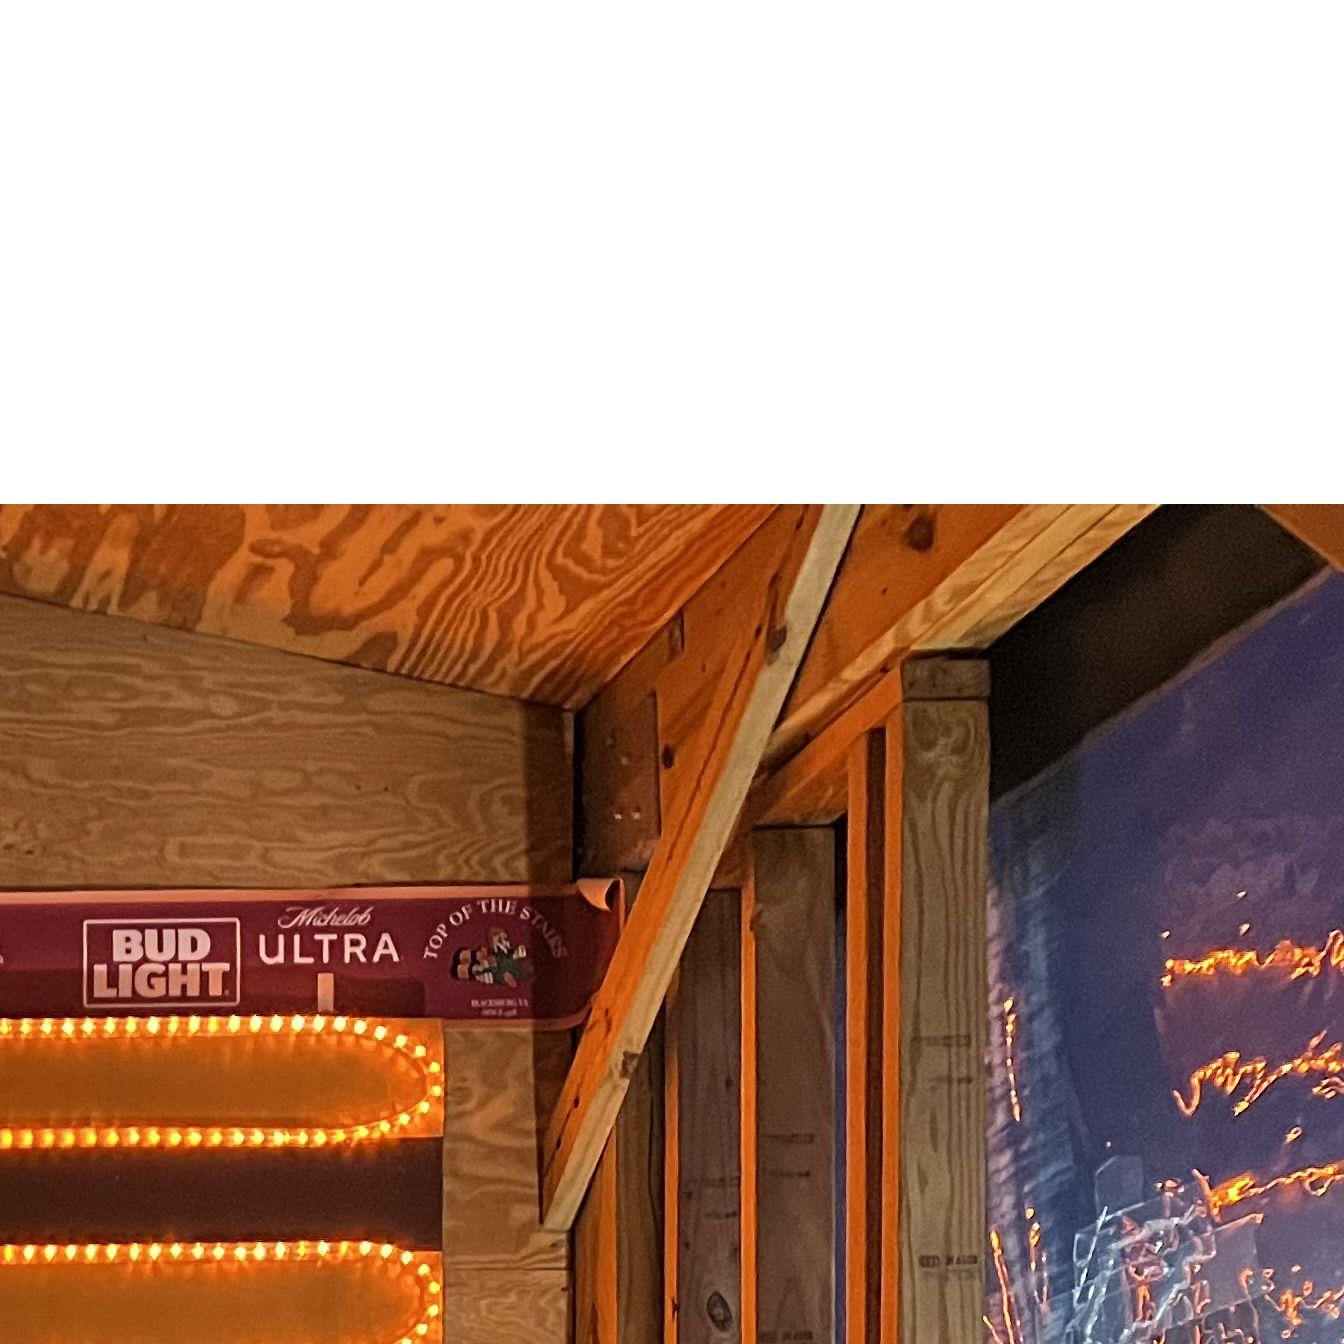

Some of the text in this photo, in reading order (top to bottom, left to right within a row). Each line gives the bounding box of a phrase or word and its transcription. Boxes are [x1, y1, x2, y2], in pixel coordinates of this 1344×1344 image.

[278, 905, 372, 929] Michelob
[423, 923, 449, 960] TOP
[449, 903, 473, 926] OF
[477, 898, 517, 916] THE
[112, 928, 212, 963] BUD
[258, 932, 400, 965] ULTRA
[92, 963, 230, 998] LIGHT
